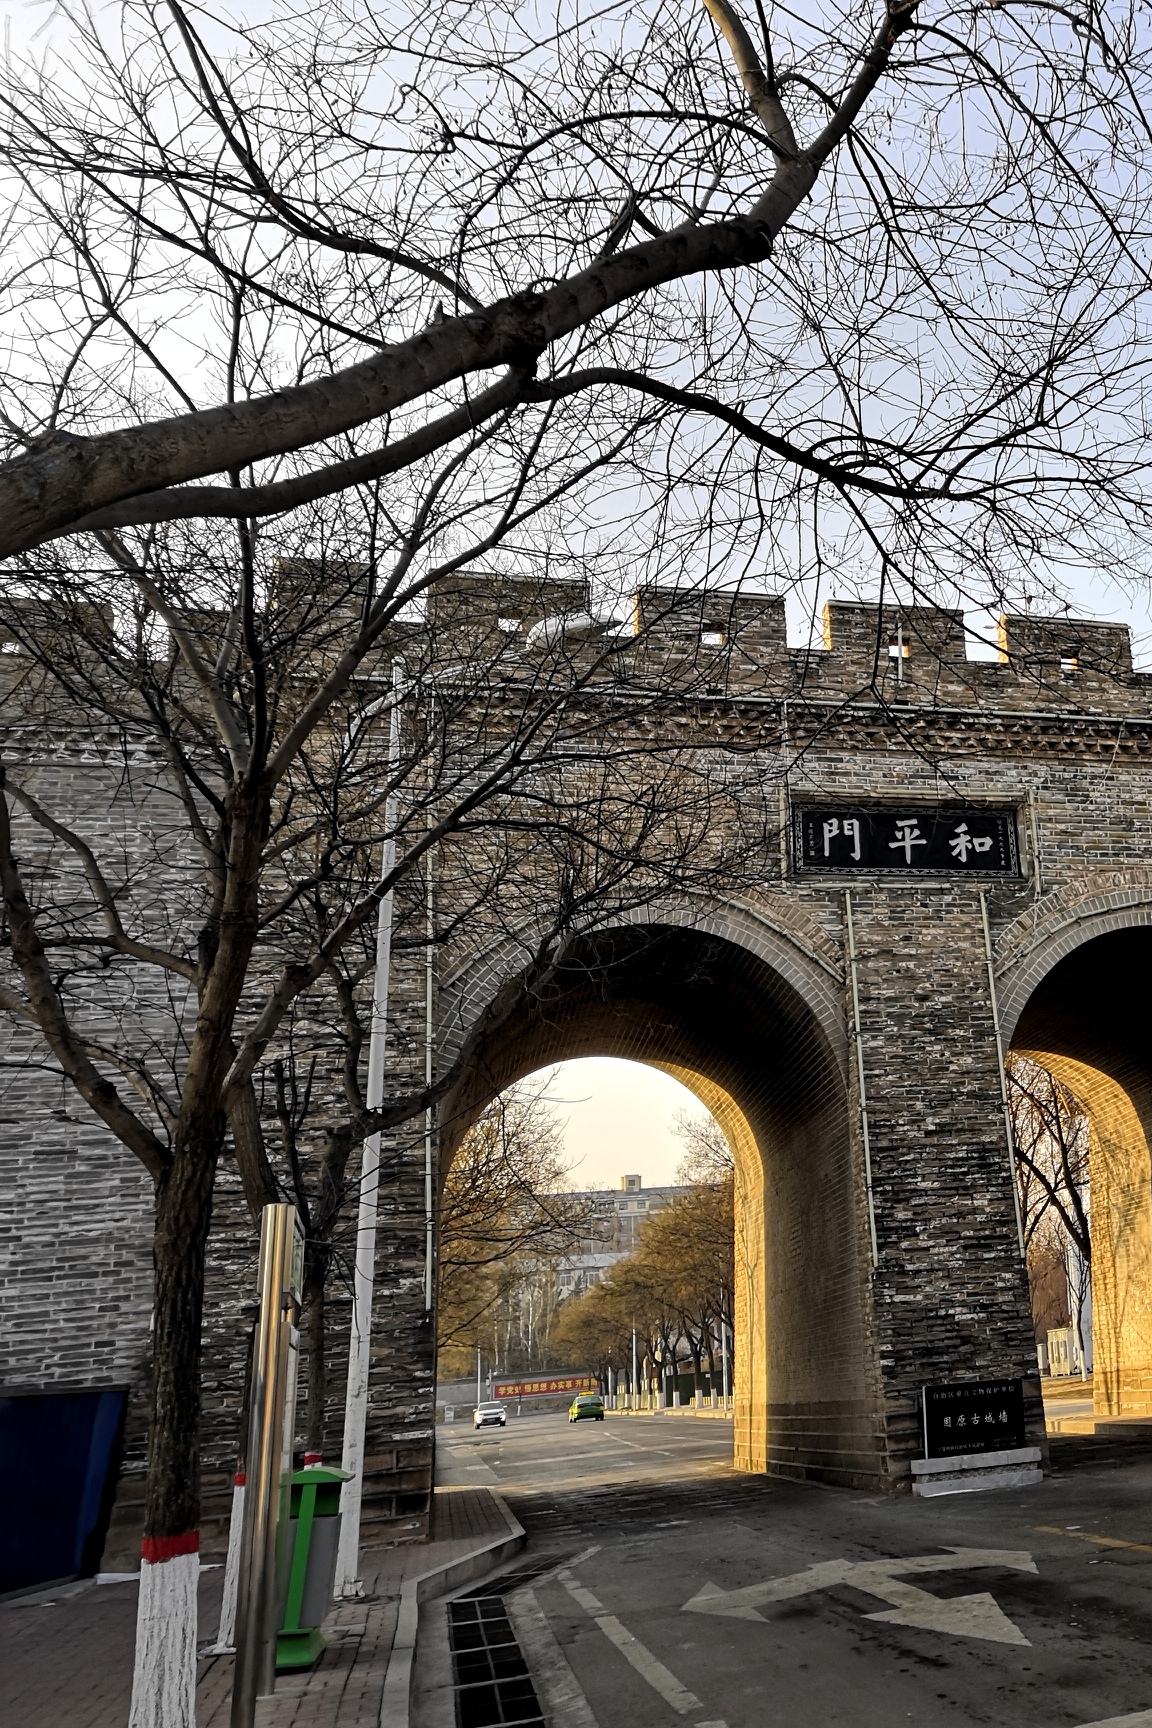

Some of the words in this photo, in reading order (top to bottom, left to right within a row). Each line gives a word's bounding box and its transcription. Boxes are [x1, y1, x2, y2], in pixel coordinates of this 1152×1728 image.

[822, 817, 994, 865] 和平門
[524, 1383, 547, 1393] 悟思想
[550, 1380, 573, 1391] 办实事
[943, 1410, 1007, 1427] 固原古城墙
